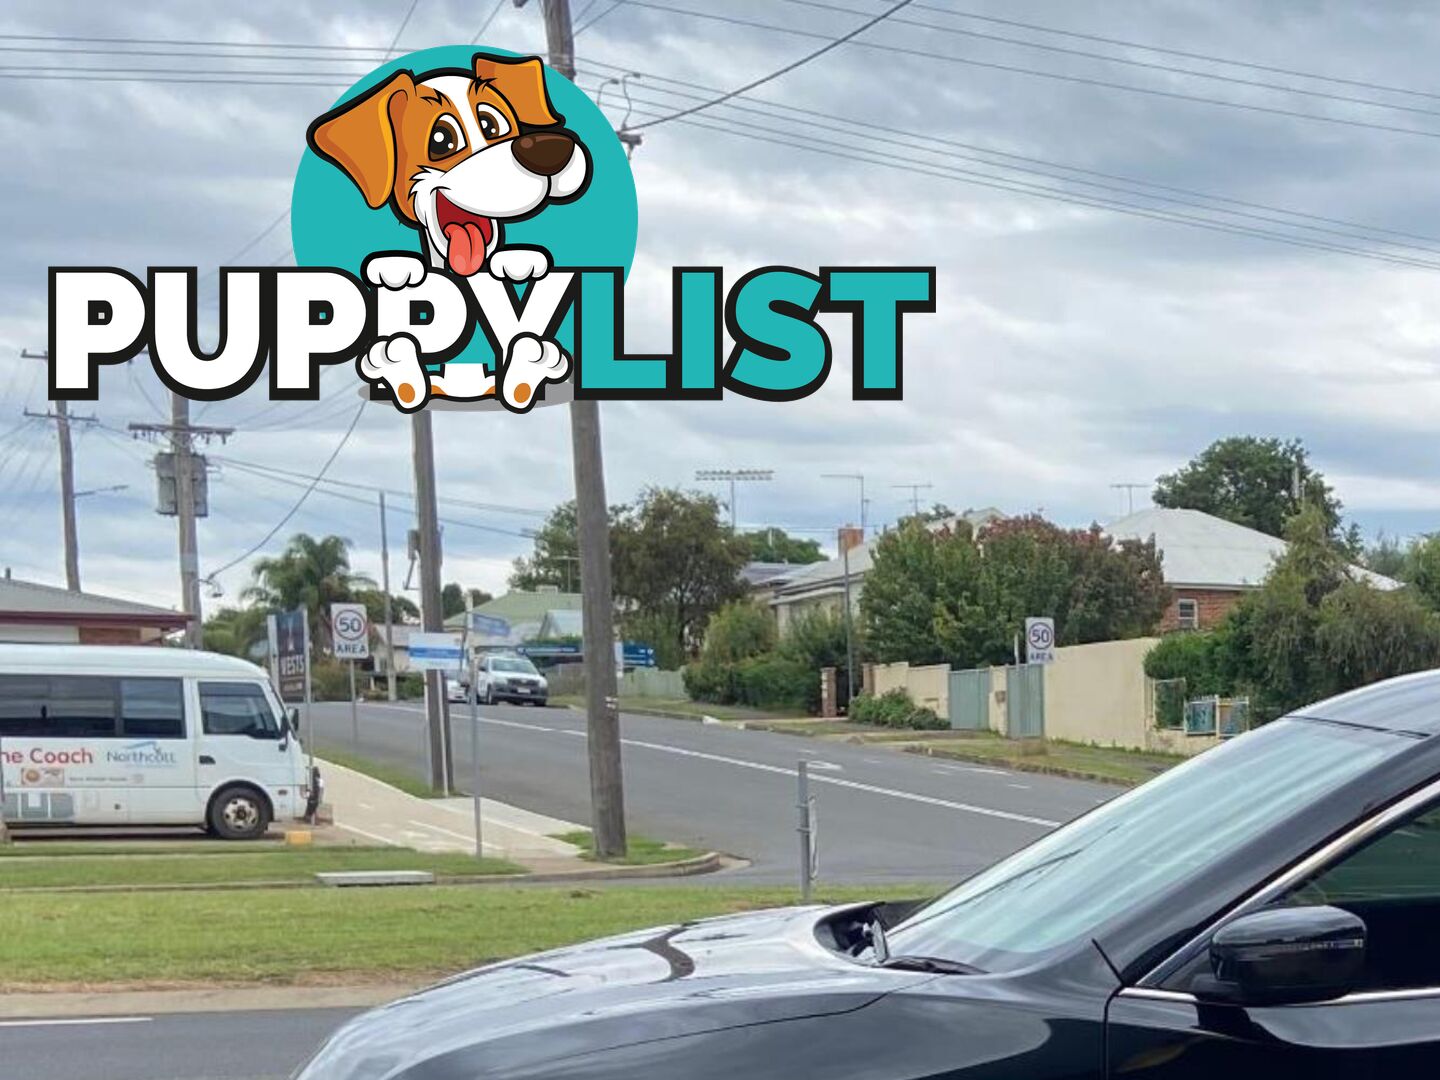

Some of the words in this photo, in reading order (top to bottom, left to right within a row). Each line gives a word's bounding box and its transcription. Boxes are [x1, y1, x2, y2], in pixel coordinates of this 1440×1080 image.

[339, 617, 361, 632] 50
[1032, 629, 1050, 643] 50
[336, 643, 366, 654] AREA
[30, 747, 93, 764] Coach
[107, 751, 178, 763] Northcott
